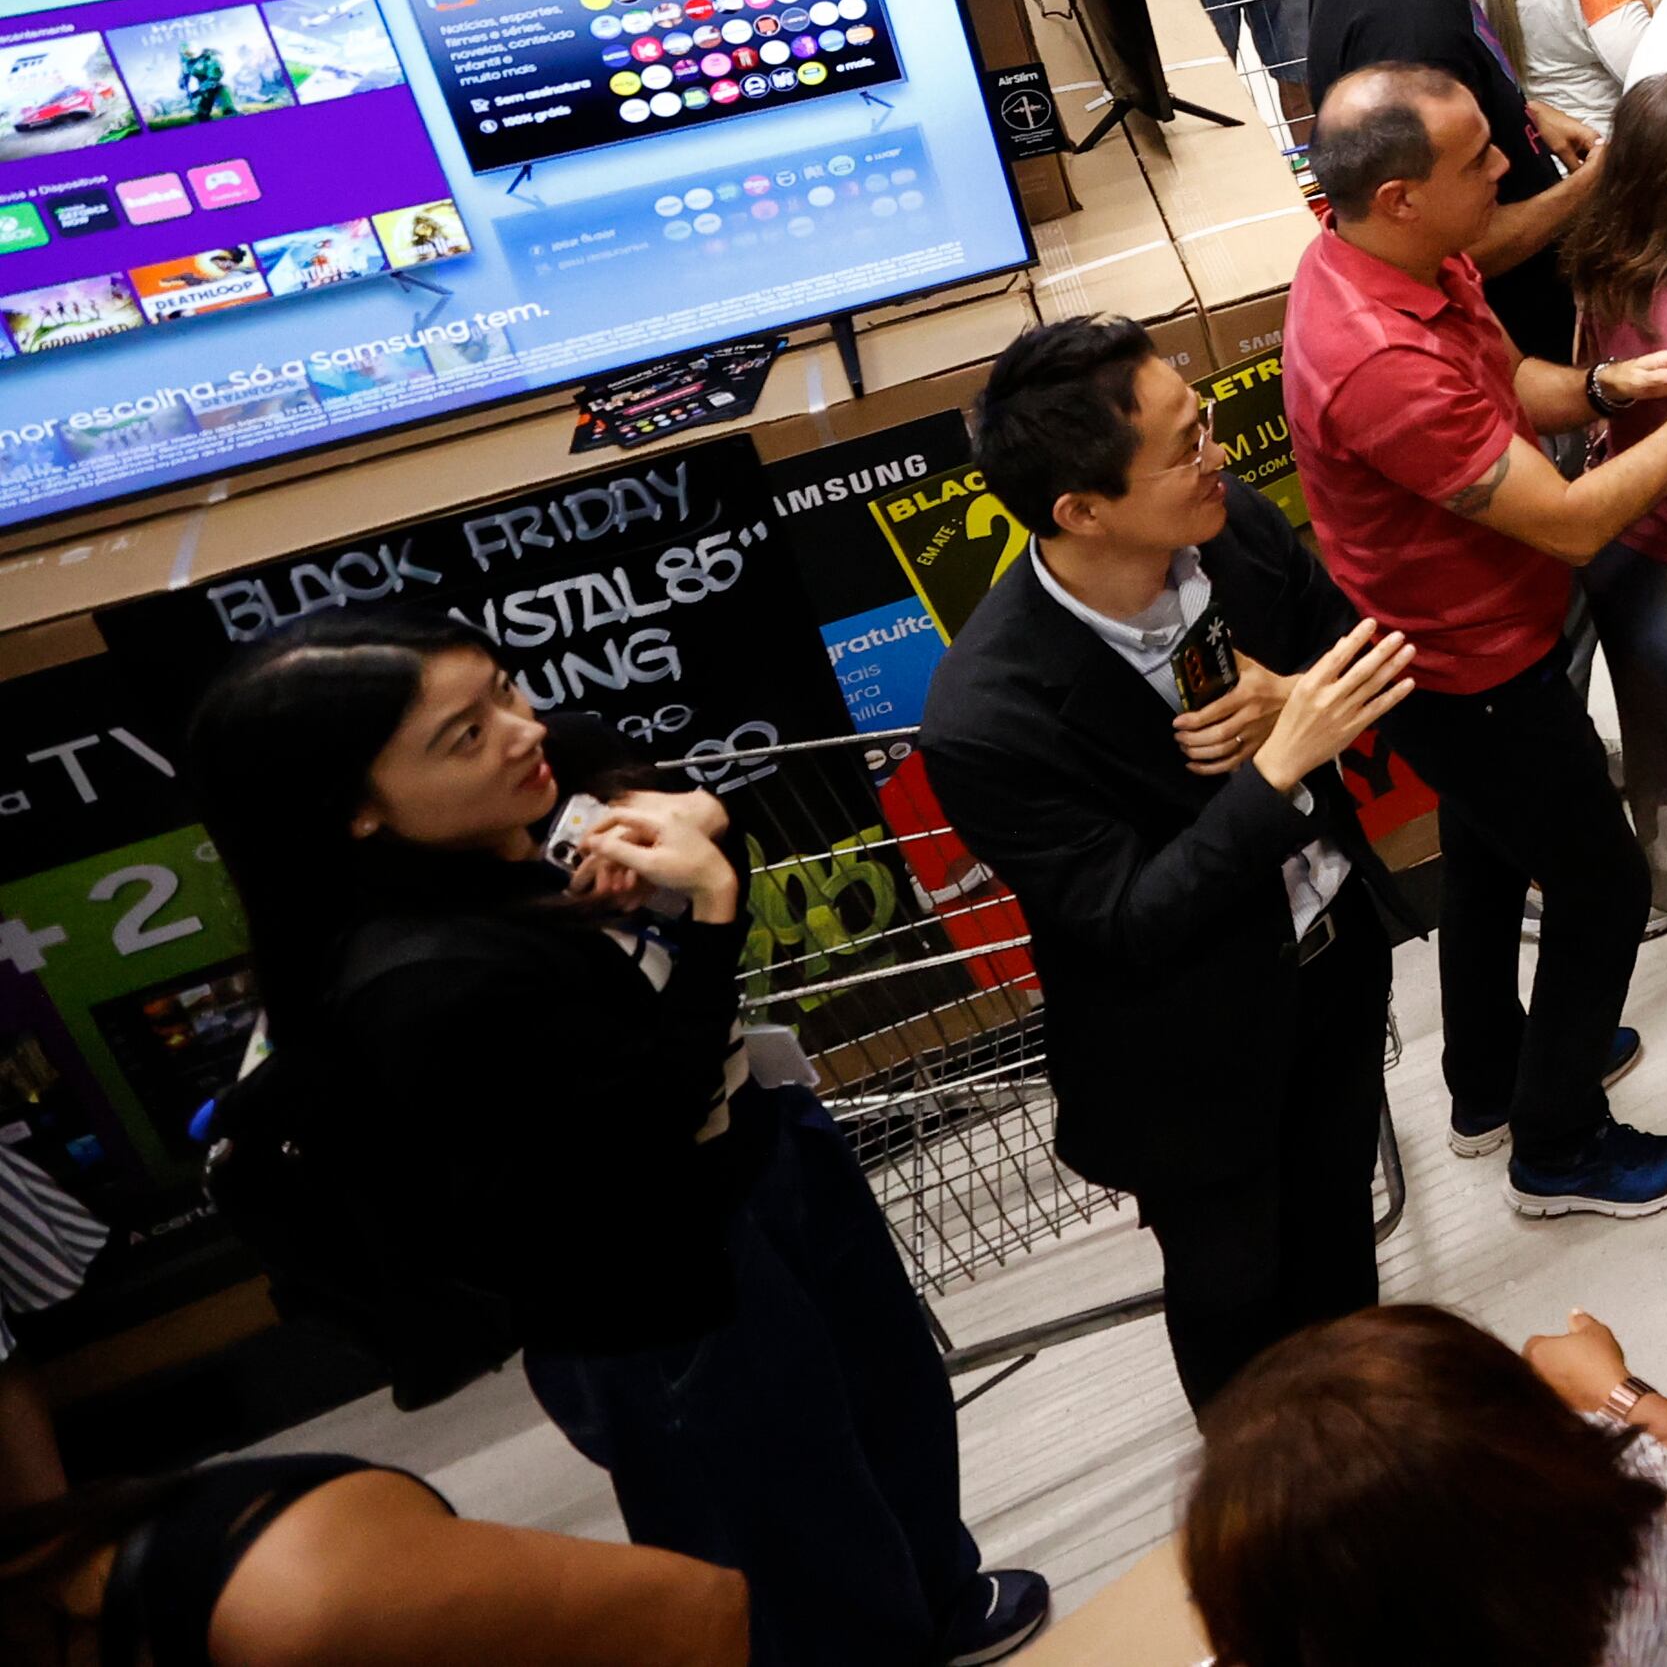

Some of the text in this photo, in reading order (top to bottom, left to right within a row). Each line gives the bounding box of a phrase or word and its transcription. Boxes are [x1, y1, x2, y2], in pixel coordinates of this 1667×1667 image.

[503, 62, 538, 79] mais
[998, 71, 1040, 87] AirSlim
[494, 78, 592, 107] Sem assinatura
[154, 280, 254, 312] DEATHLOOP
[68, 376, 227, 434] escolha.
[228, 353, 274, 390] Só
[284, 361, 306, 381] a
[307, 319, 471, 374] Samsung
[472, 297, 550, 333] tem.
[207, 460, 688, 643] BLACK FRIDAY
[88, 863, 204, 956] 2
